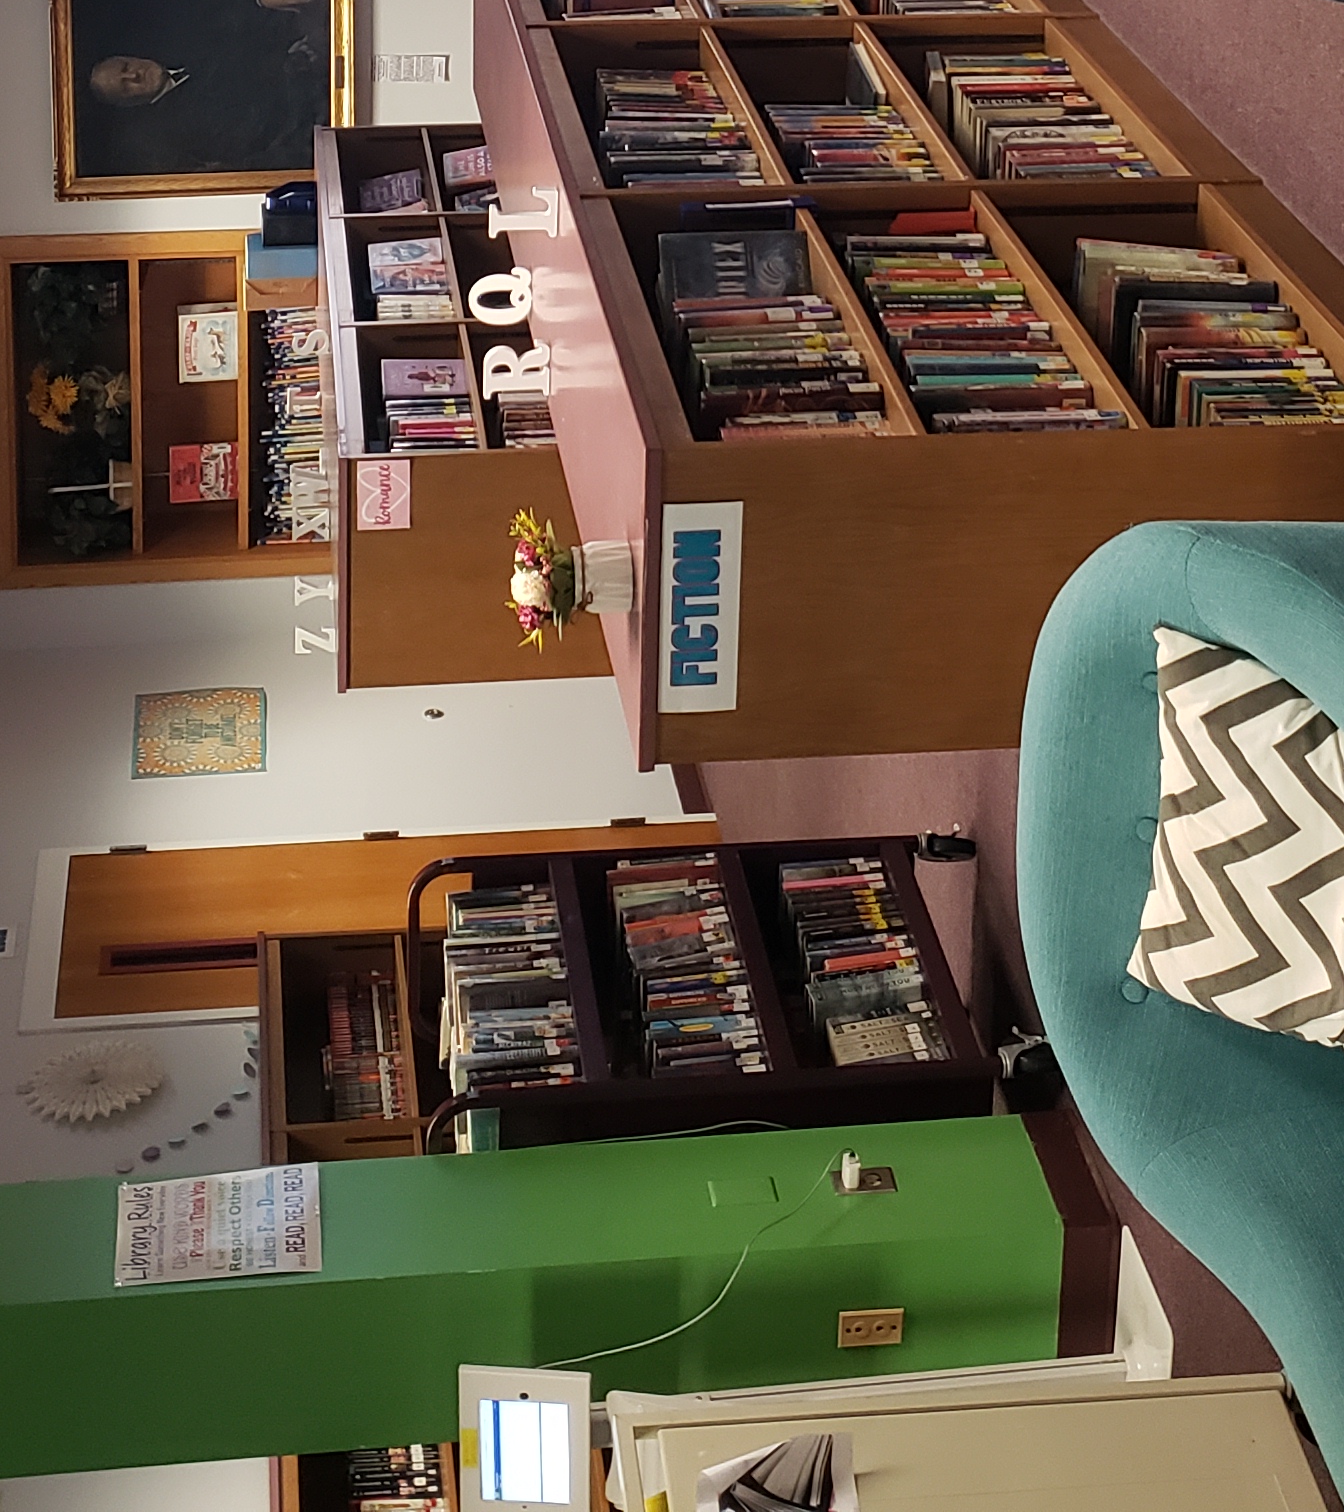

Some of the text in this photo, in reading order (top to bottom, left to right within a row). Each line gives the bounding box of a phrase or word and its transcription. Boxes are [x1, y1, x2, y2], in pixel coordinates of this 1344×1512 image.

[477, 158, 486, 176] ALSO
[467, 186, 559, 400] R Q L
[291, 329, 330, 356] S
[287, 386, 322, 414] T
[373, 463, 392, 525] Romance
[291, 507, 330, 541] X
[294, 575, 334, 606] Y
[669, 529, 722, 687] FICTION
[294, 626, 335, 654] Z
[283, 1168, 303, 1192] READ
[121, 1186, 157, 1281] Library Rules
[189, 1181, 205, 1257] Please Thank You
[215, 1209, 229, 1235] quiet
[228, 1175, 244, 1271] Respect Others
[259, 1237, 276, 1269] Listen
